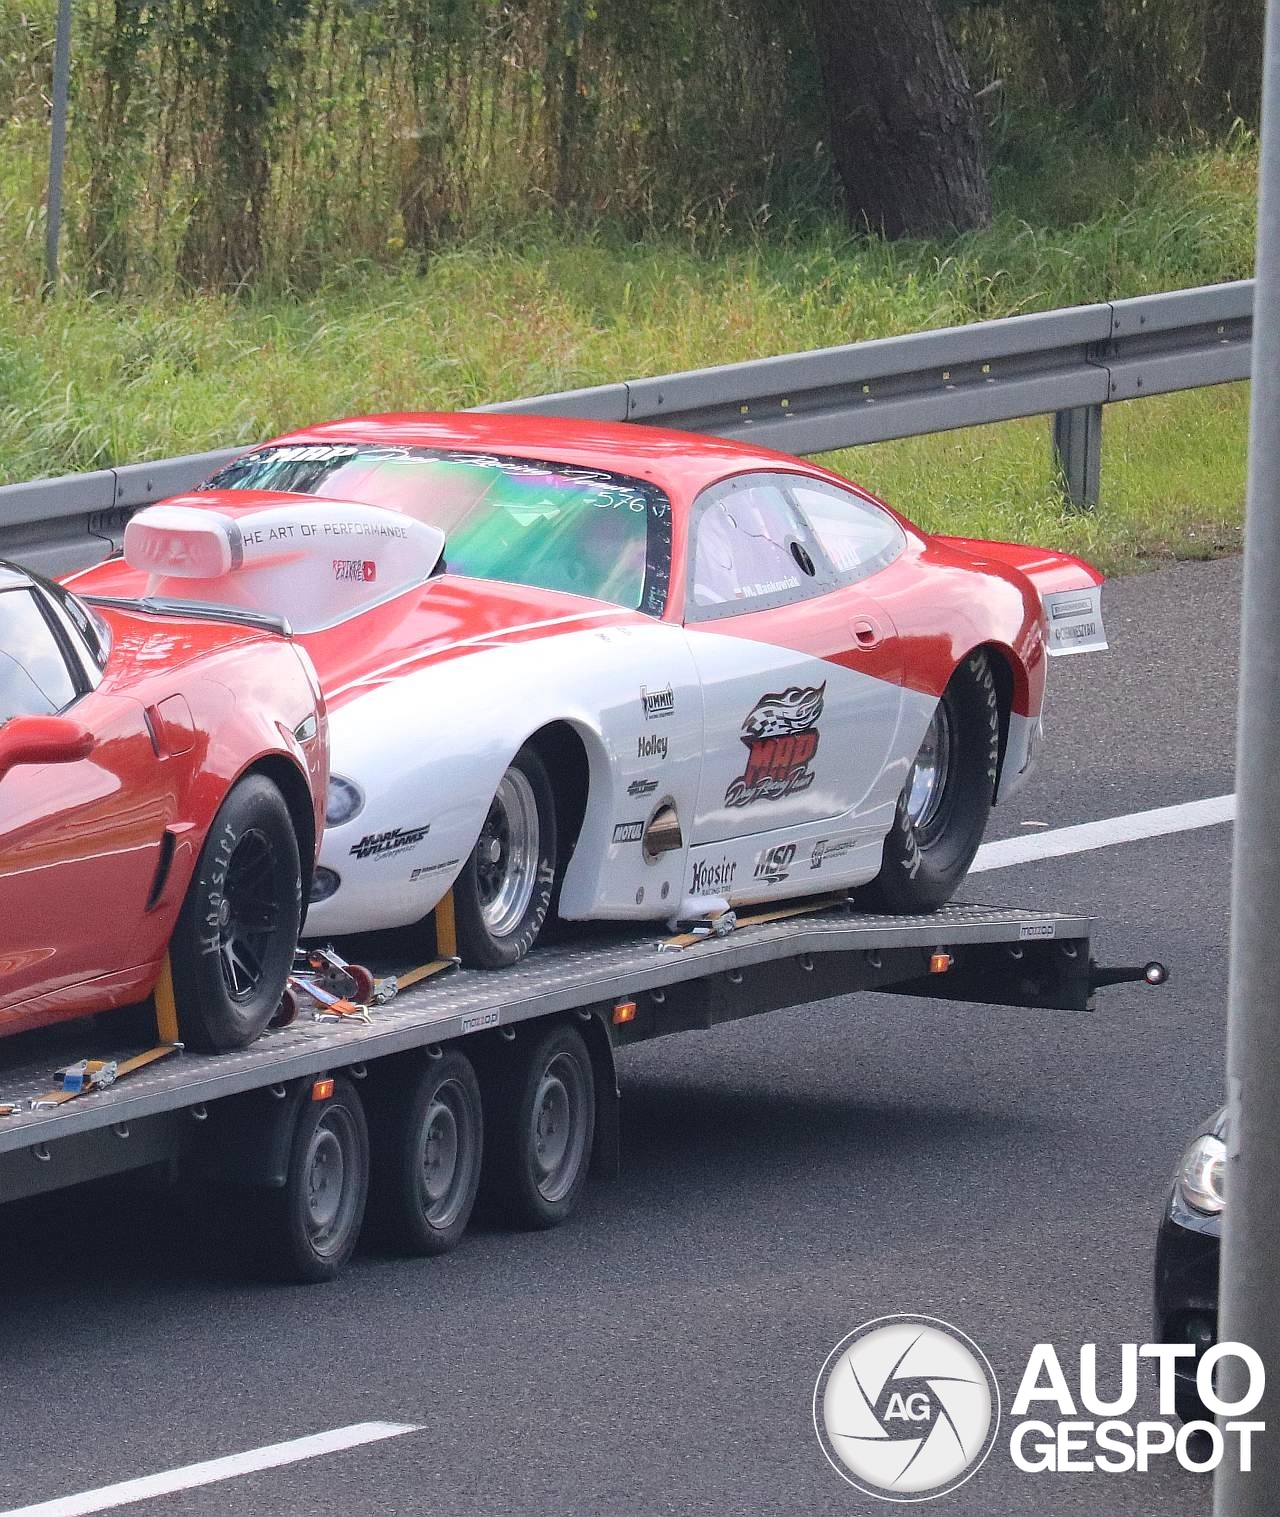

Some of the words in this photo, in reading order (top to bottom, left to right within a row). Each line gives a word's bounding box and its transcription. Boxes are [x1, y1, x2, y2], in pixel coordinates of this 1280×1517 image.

[594, 491, 647, 512] 576
[242, 530, 263, 547] HE
[270, 525, 294, 541] ART
[302, 524, 318, 536] OF
[324, 523, 408, 539] PERFORMANCE
[638, 734, 669, 760] Holley
[614, 825, 642, 841] MOTUL
[754, 843, 798, 877] MSD
[689, 855, 738, 895] Hoosier
